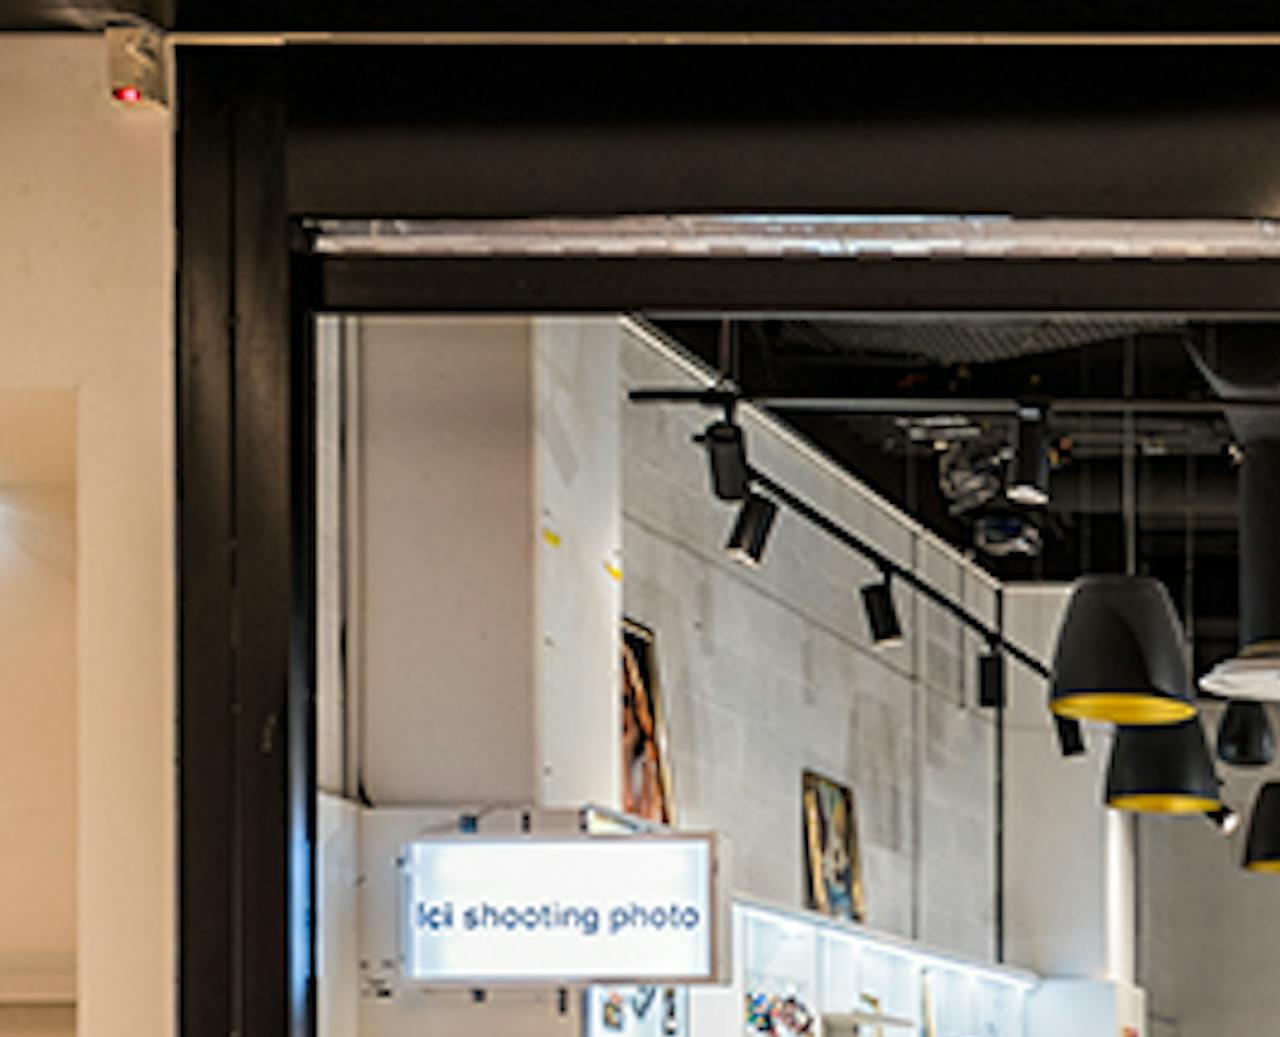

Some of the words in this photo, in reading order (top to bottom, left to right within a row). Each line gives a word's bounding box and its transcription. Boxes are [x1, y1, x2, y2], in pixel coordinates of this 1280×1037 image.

[416, 902, 454, 930] Ici
[463, 902, 600, 934] shooting
[609, 902, 700, 934] photo
